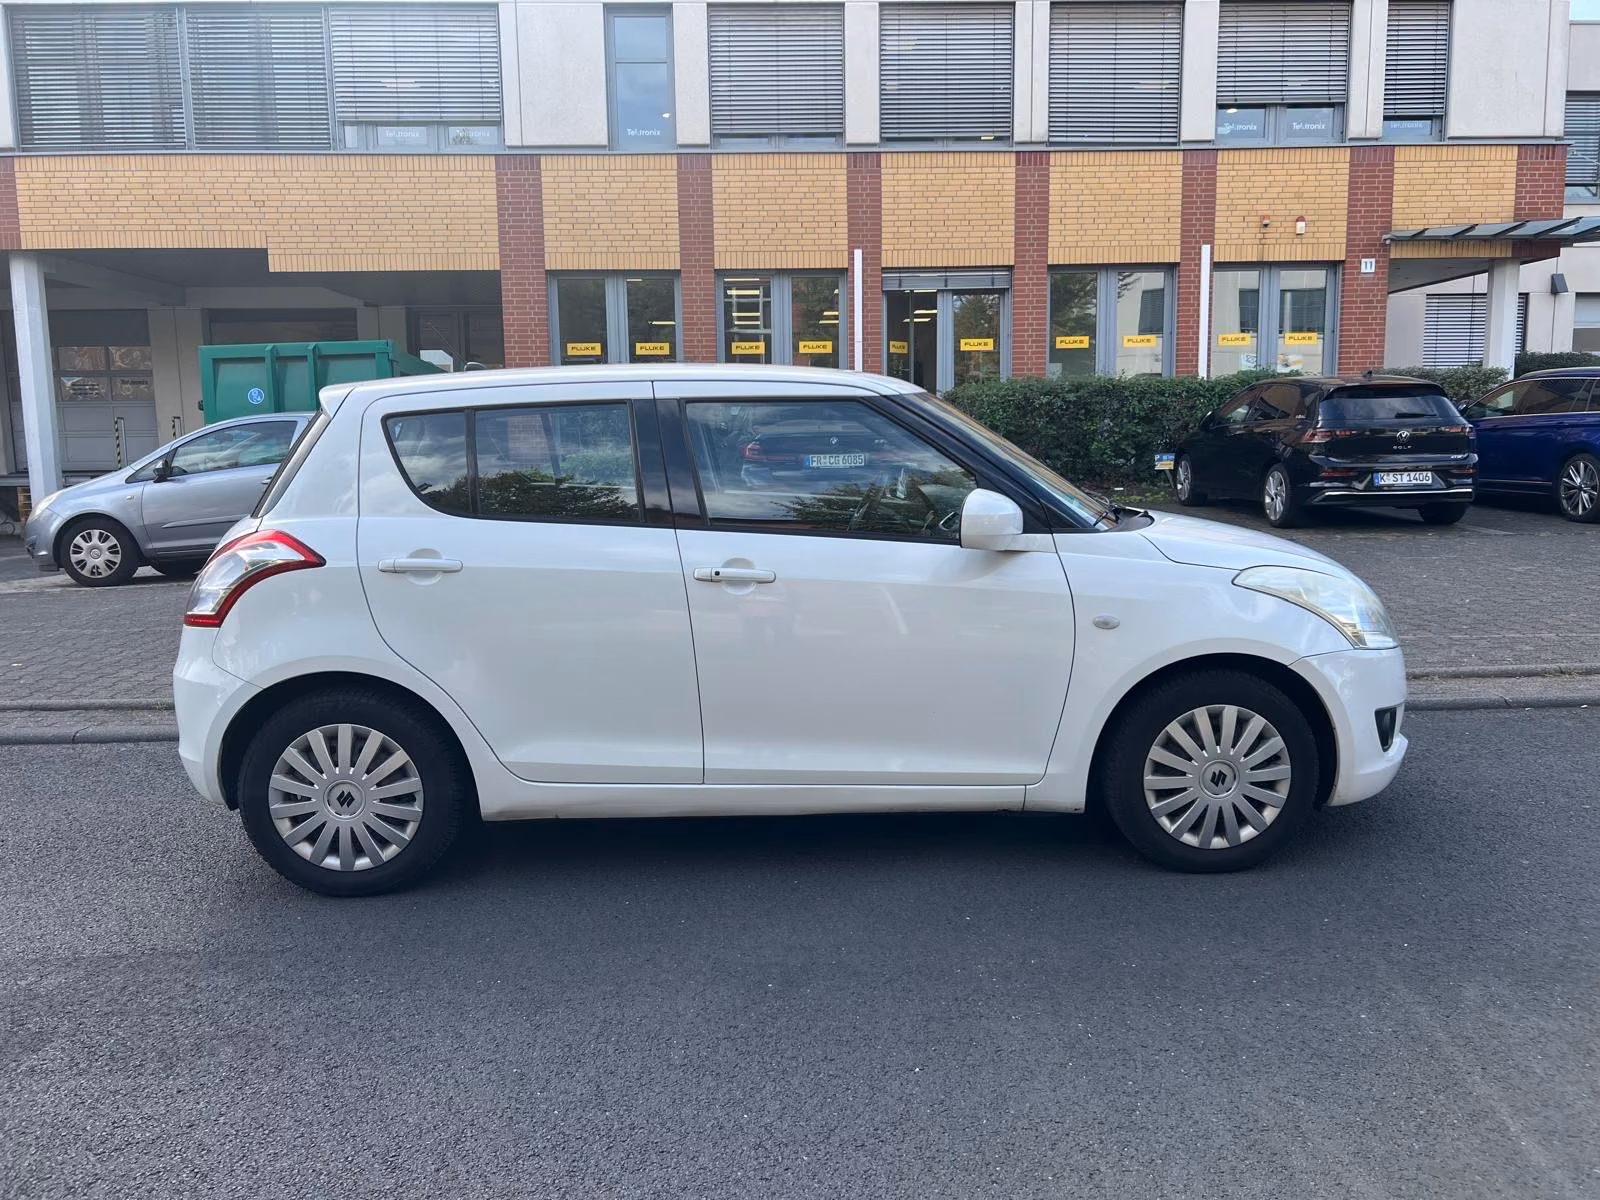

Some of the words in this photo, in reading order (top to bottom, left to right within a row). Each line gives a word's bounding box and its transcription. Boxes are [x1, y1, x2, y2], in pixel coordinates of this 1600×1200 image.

[1363, 260, 1373, 271] 11
[811, 455, 821, 466] FR
[1380, 473, 1386, 483] K
